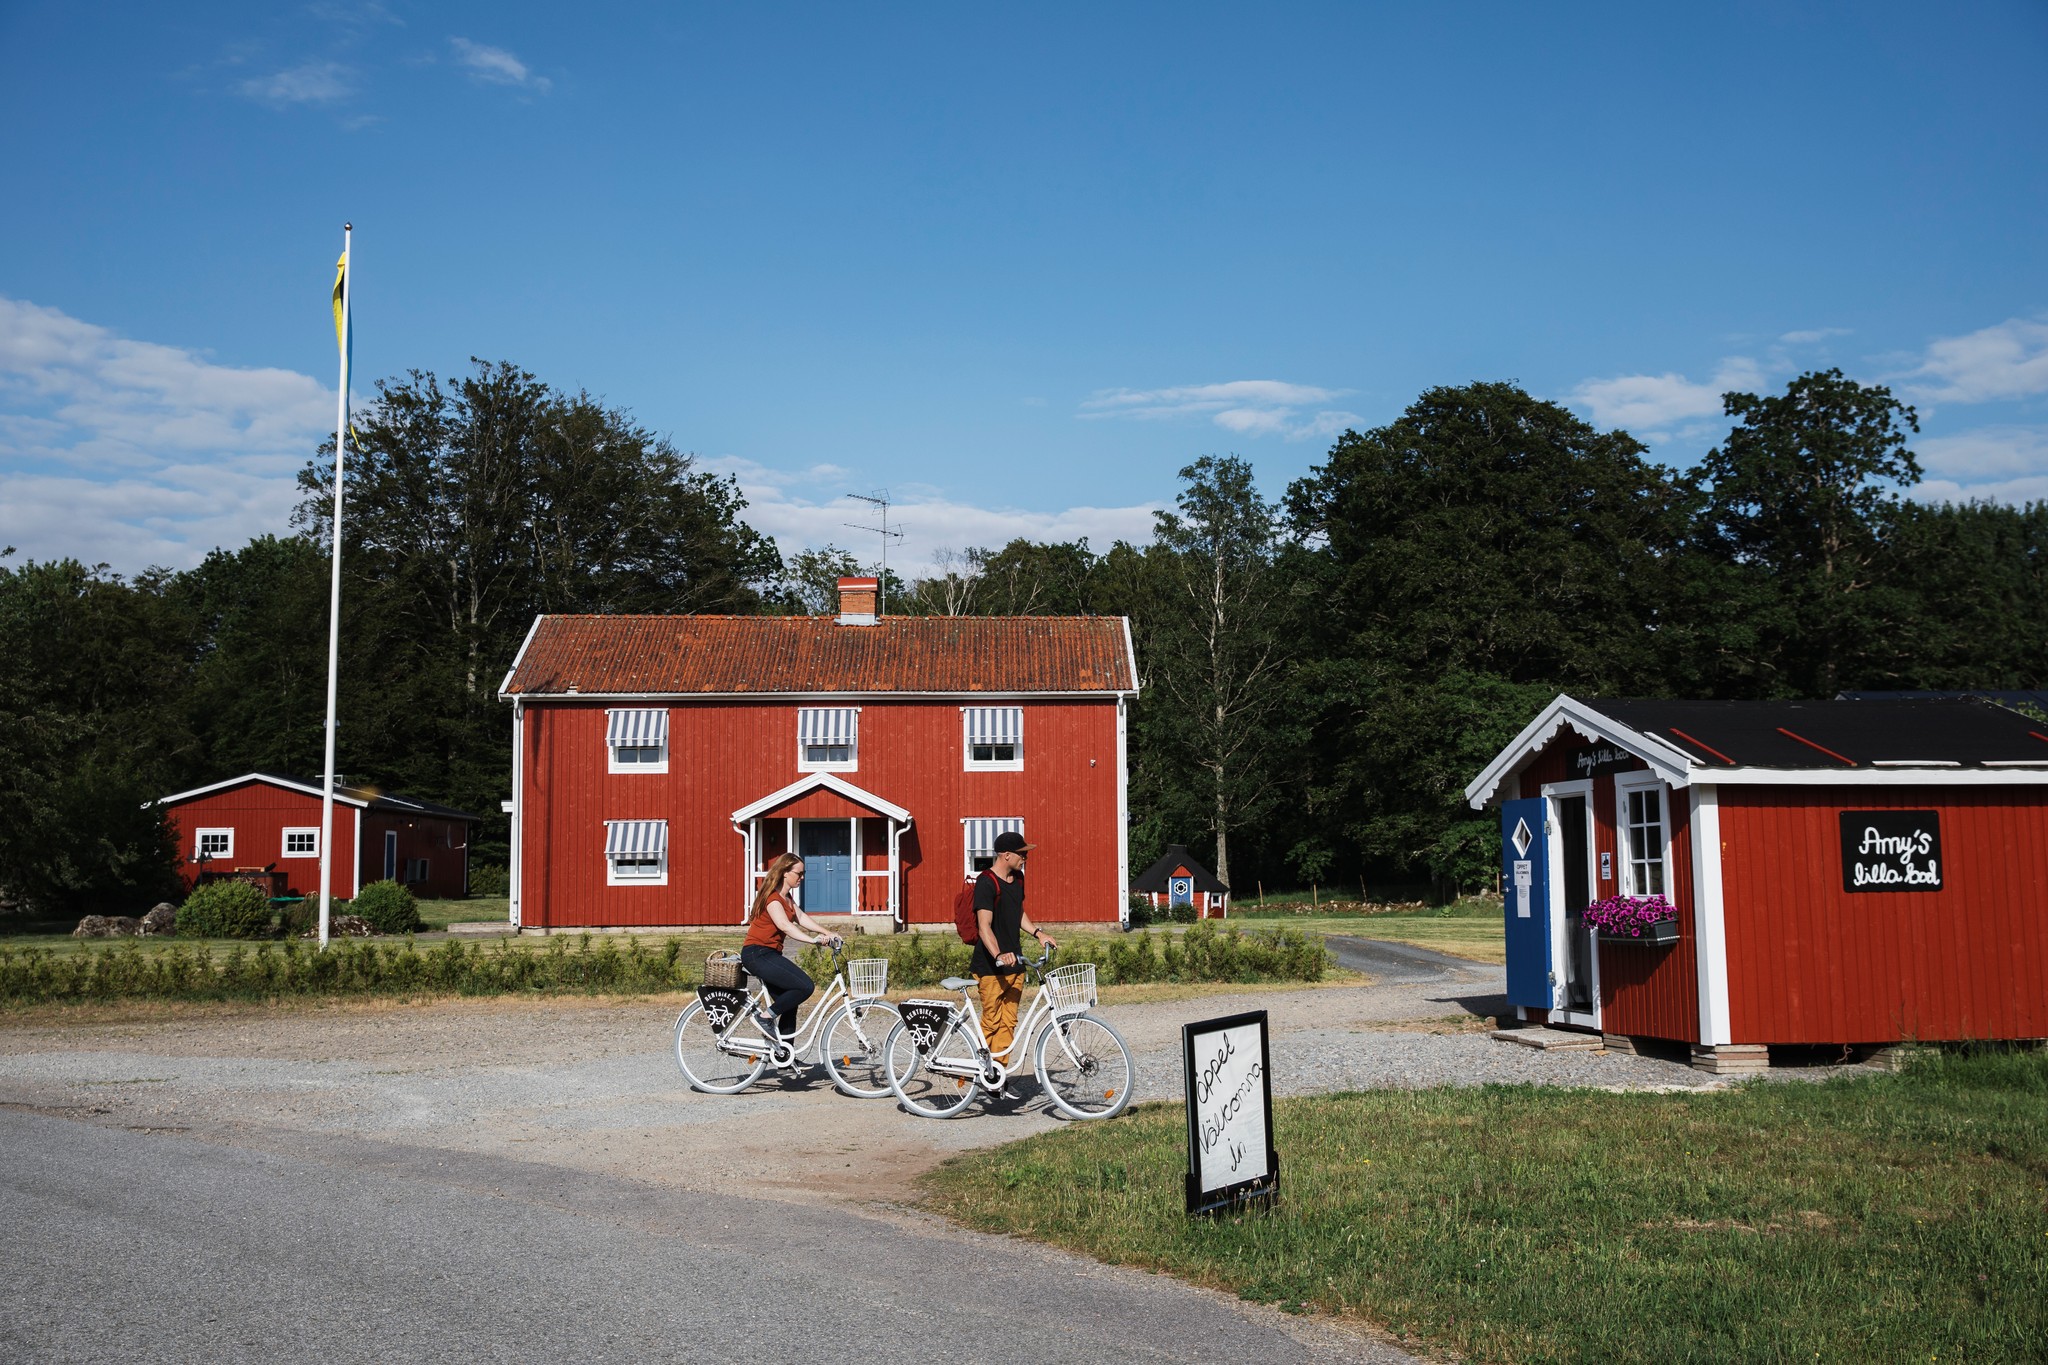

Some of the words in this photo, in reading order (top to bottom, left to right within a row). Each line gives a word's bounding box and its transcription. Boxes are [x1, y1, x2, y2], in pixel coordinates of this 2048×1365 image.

[1859, 827, 1933, 864] Amy's
[1853, 862, 1903, 886] lilla
[1904, 859, 1941, 885] bod
